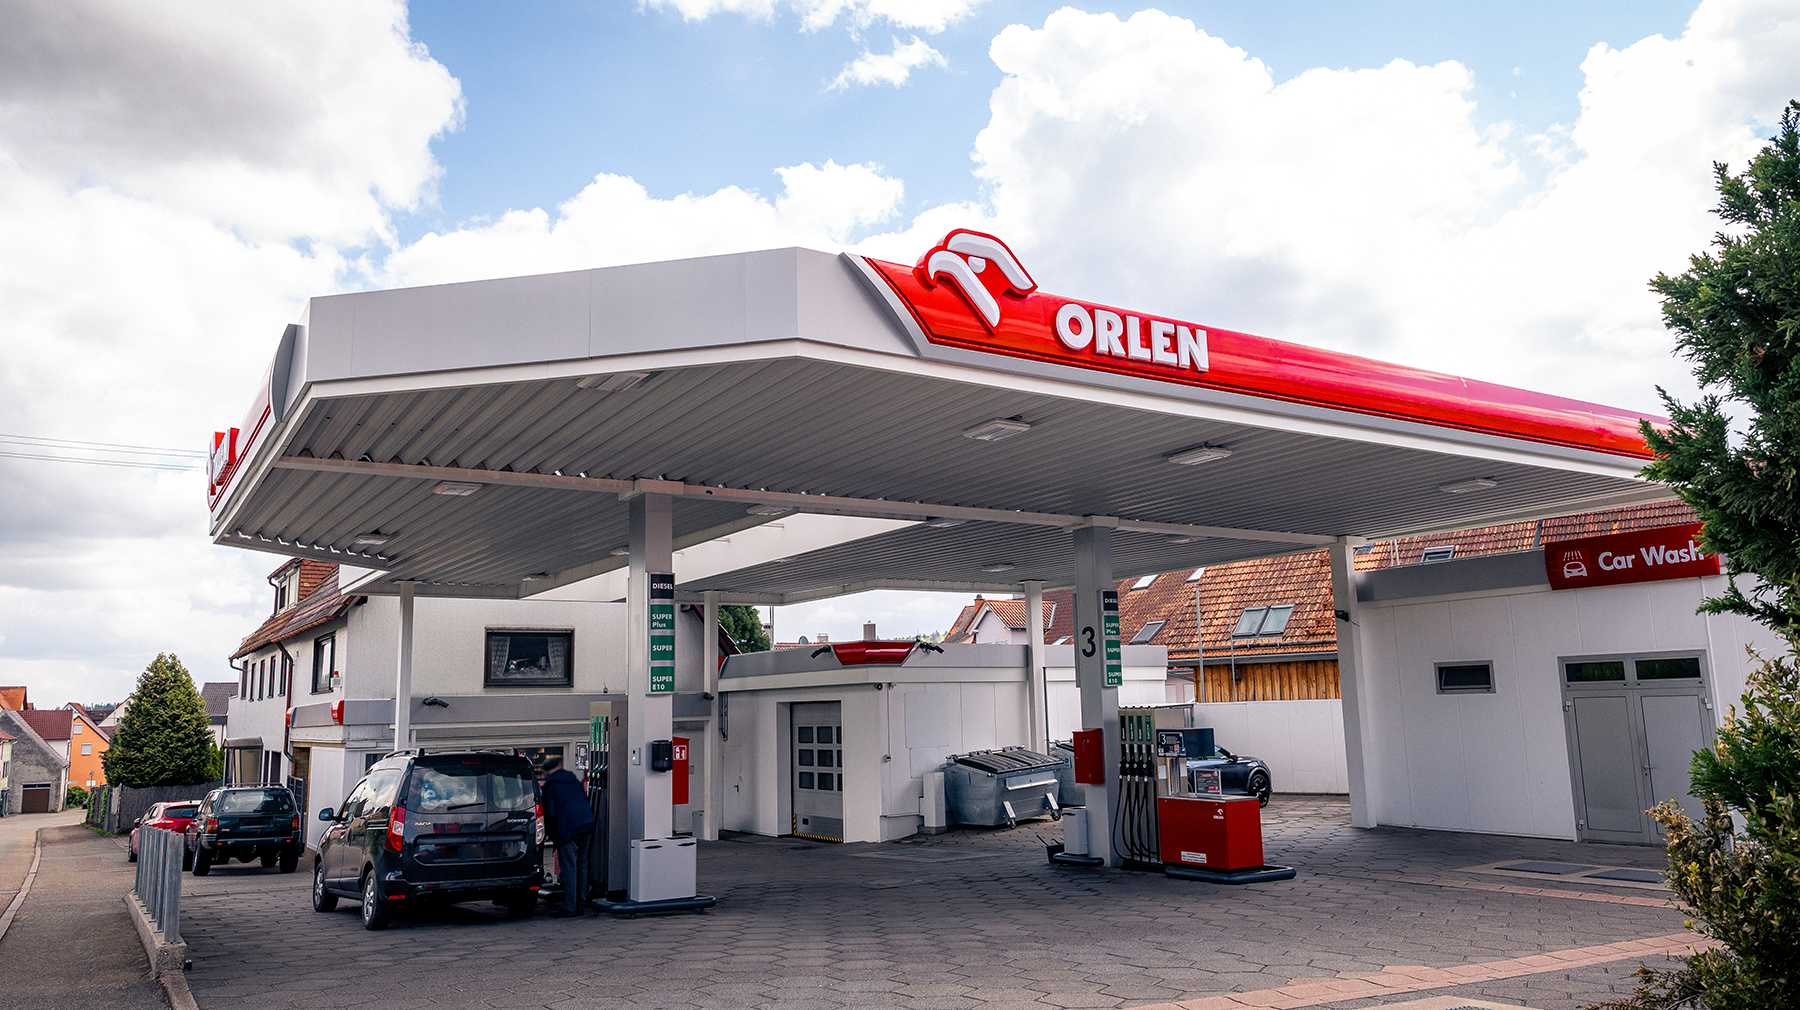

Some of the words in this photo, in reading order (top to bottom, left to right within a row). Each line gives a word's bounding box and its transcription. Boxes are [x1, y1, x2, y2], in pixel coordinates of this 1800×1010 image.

[1054, 302, 1210, 372] ORLEN
[1598, 551, 1635, 571] Car
[1640, 539, 1705, 566] Wash
[652, 644, 673, 652] SUPER
[1081, 626, 1096, 658] 3
[652, 683, 666, 691] E10
[613, 715, 620, 727] 1
[1160, 733, 1167, 746] 3
